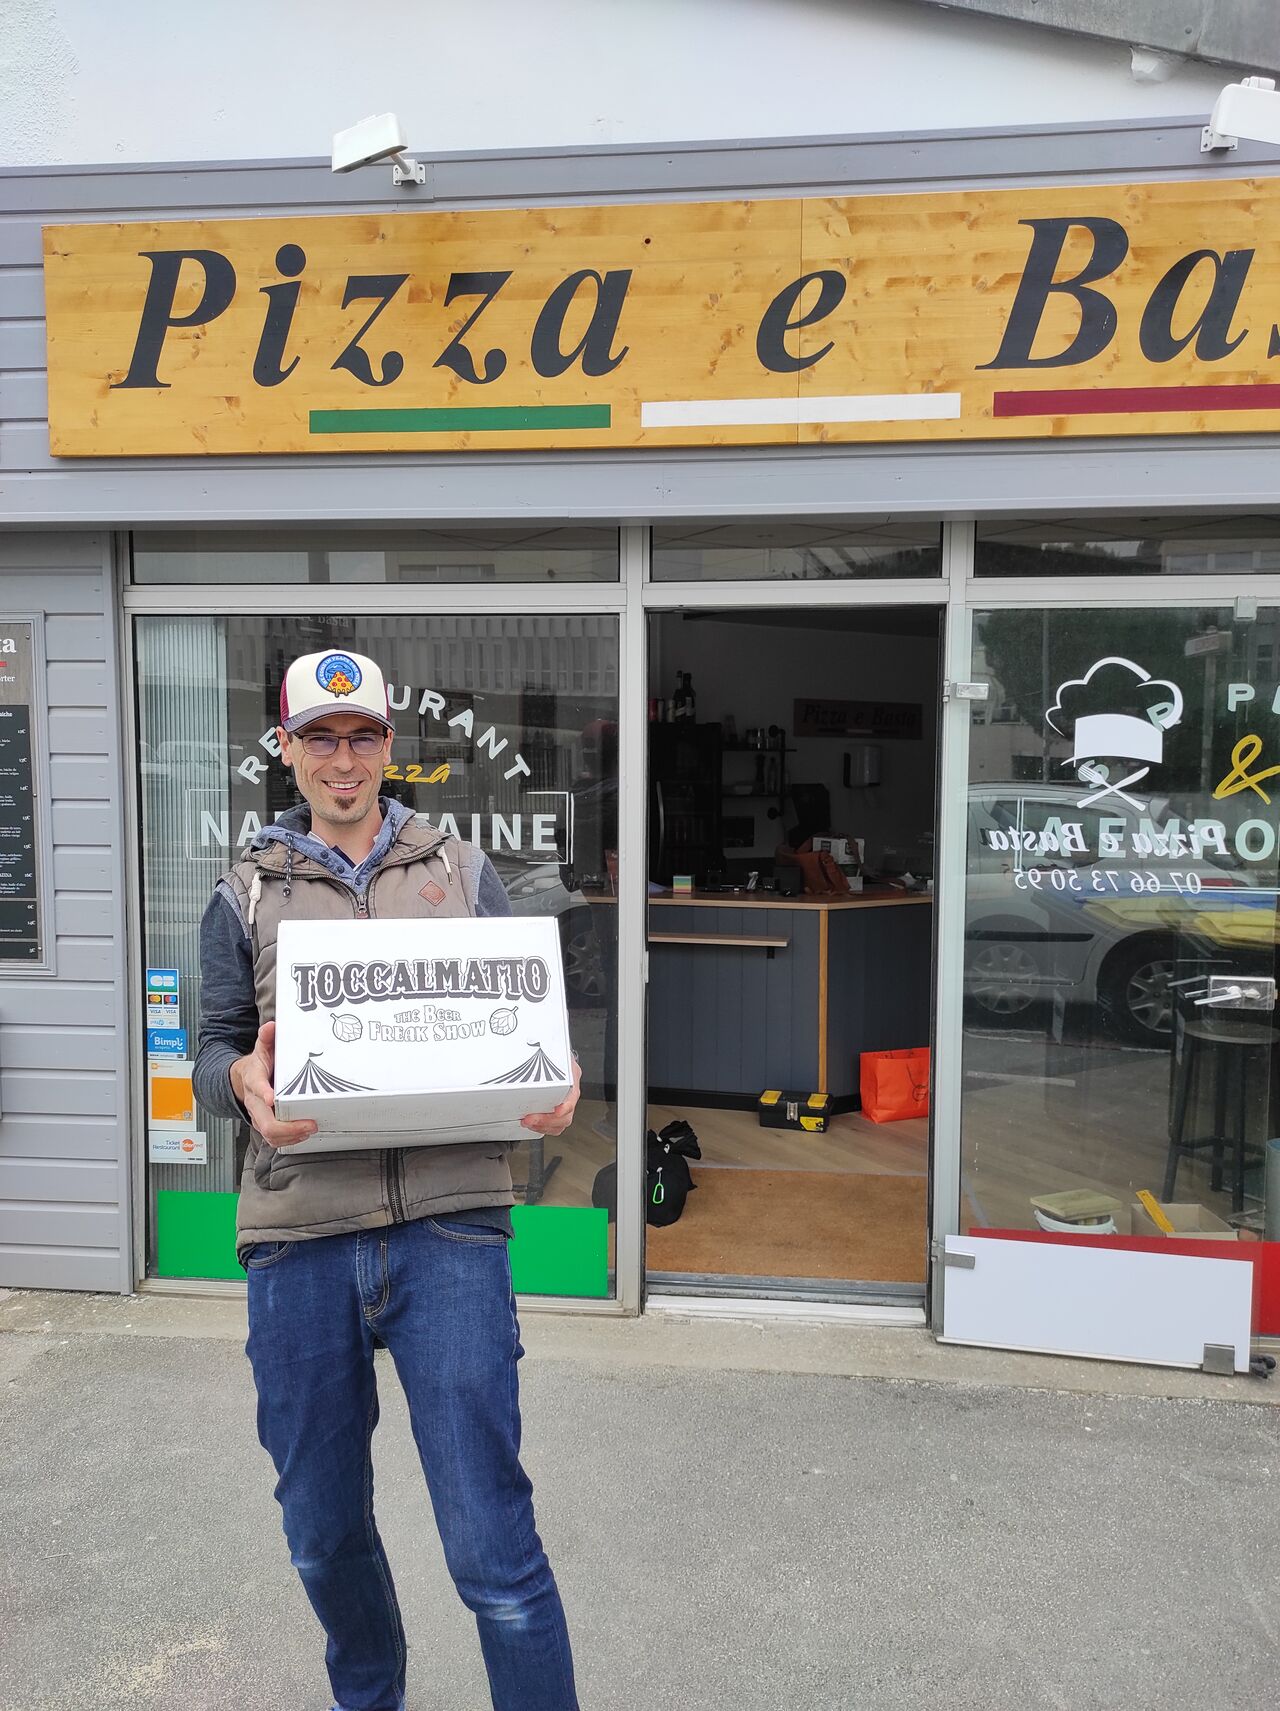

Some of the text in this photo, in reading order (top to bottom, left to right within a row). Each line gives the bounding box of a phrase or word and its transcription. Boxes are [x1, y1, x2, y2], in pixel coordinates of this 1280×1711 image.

[111, 217, 1280, 388] Pizza e Ba
[237, 683, 532, 785] REURANT
[200, 810, 558, 852] NAAINE
[291, 956, 551, 1012] TOCCALMATTO
